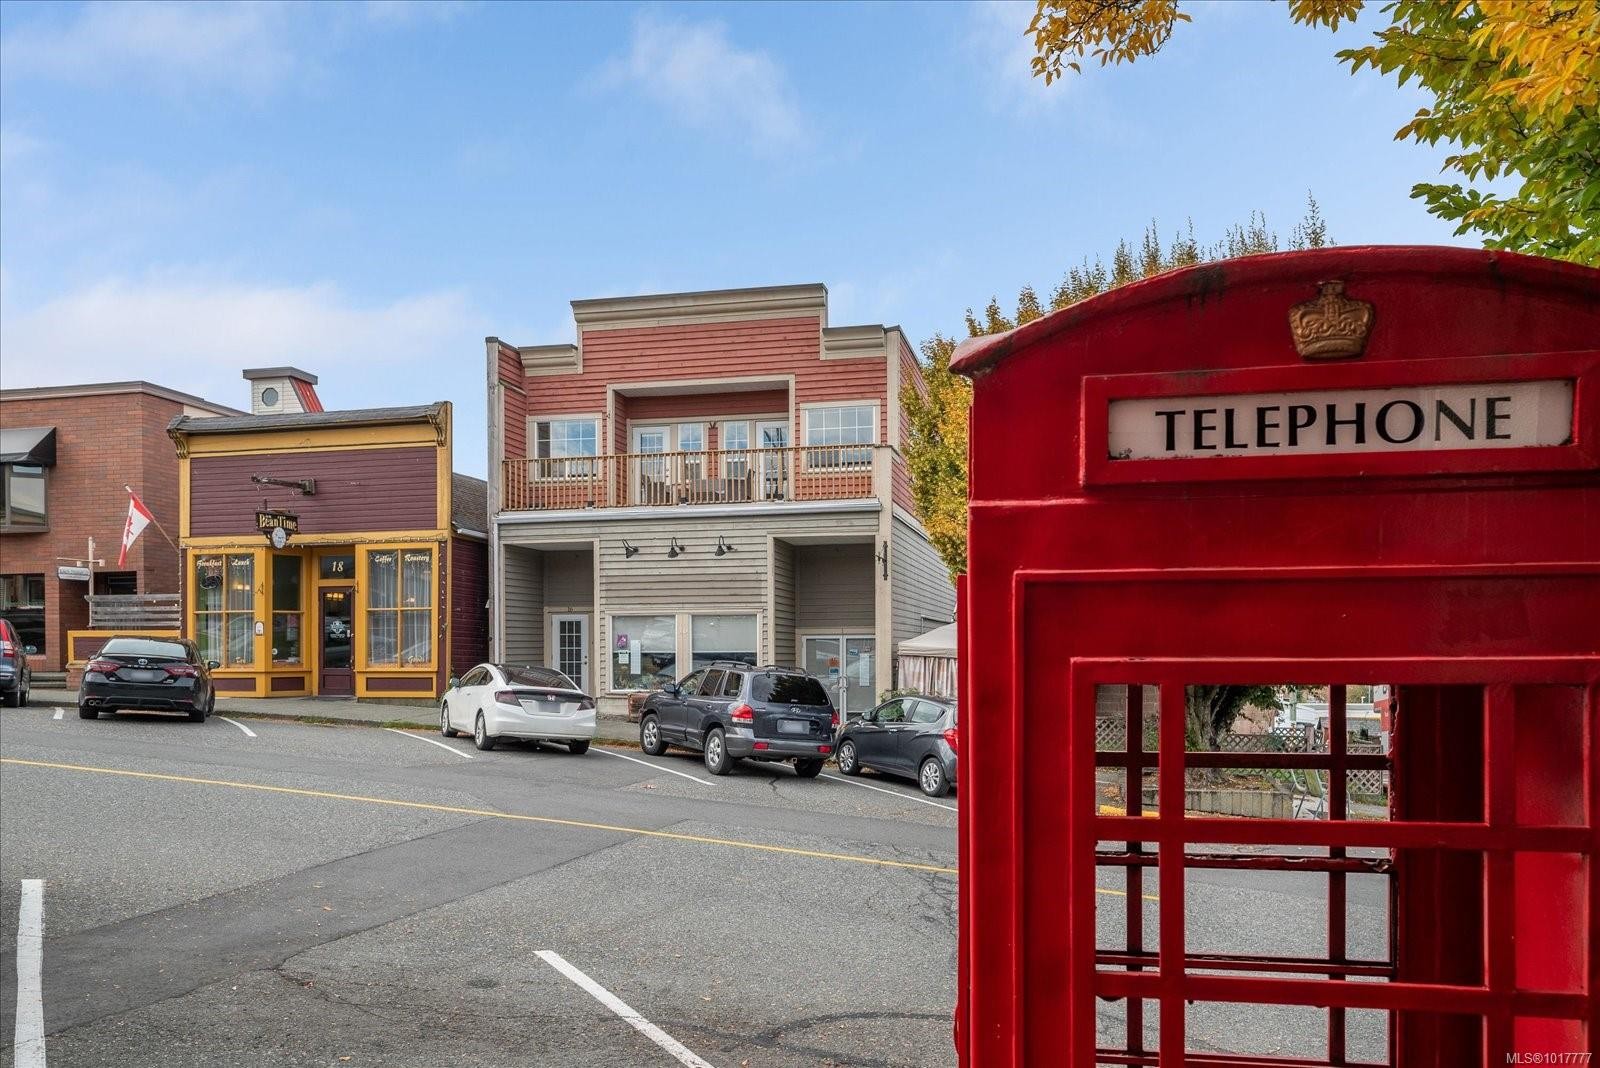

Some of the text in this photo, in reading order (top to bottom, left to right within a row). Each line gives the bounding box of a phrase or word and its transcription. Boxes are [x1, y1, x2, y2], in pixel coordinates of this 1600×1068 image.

[1155, 396, 1512, 452] TELEPHONE
[374, 554, 430, 564] Coffee Roastery
[332, 560, 344, 572] 18
